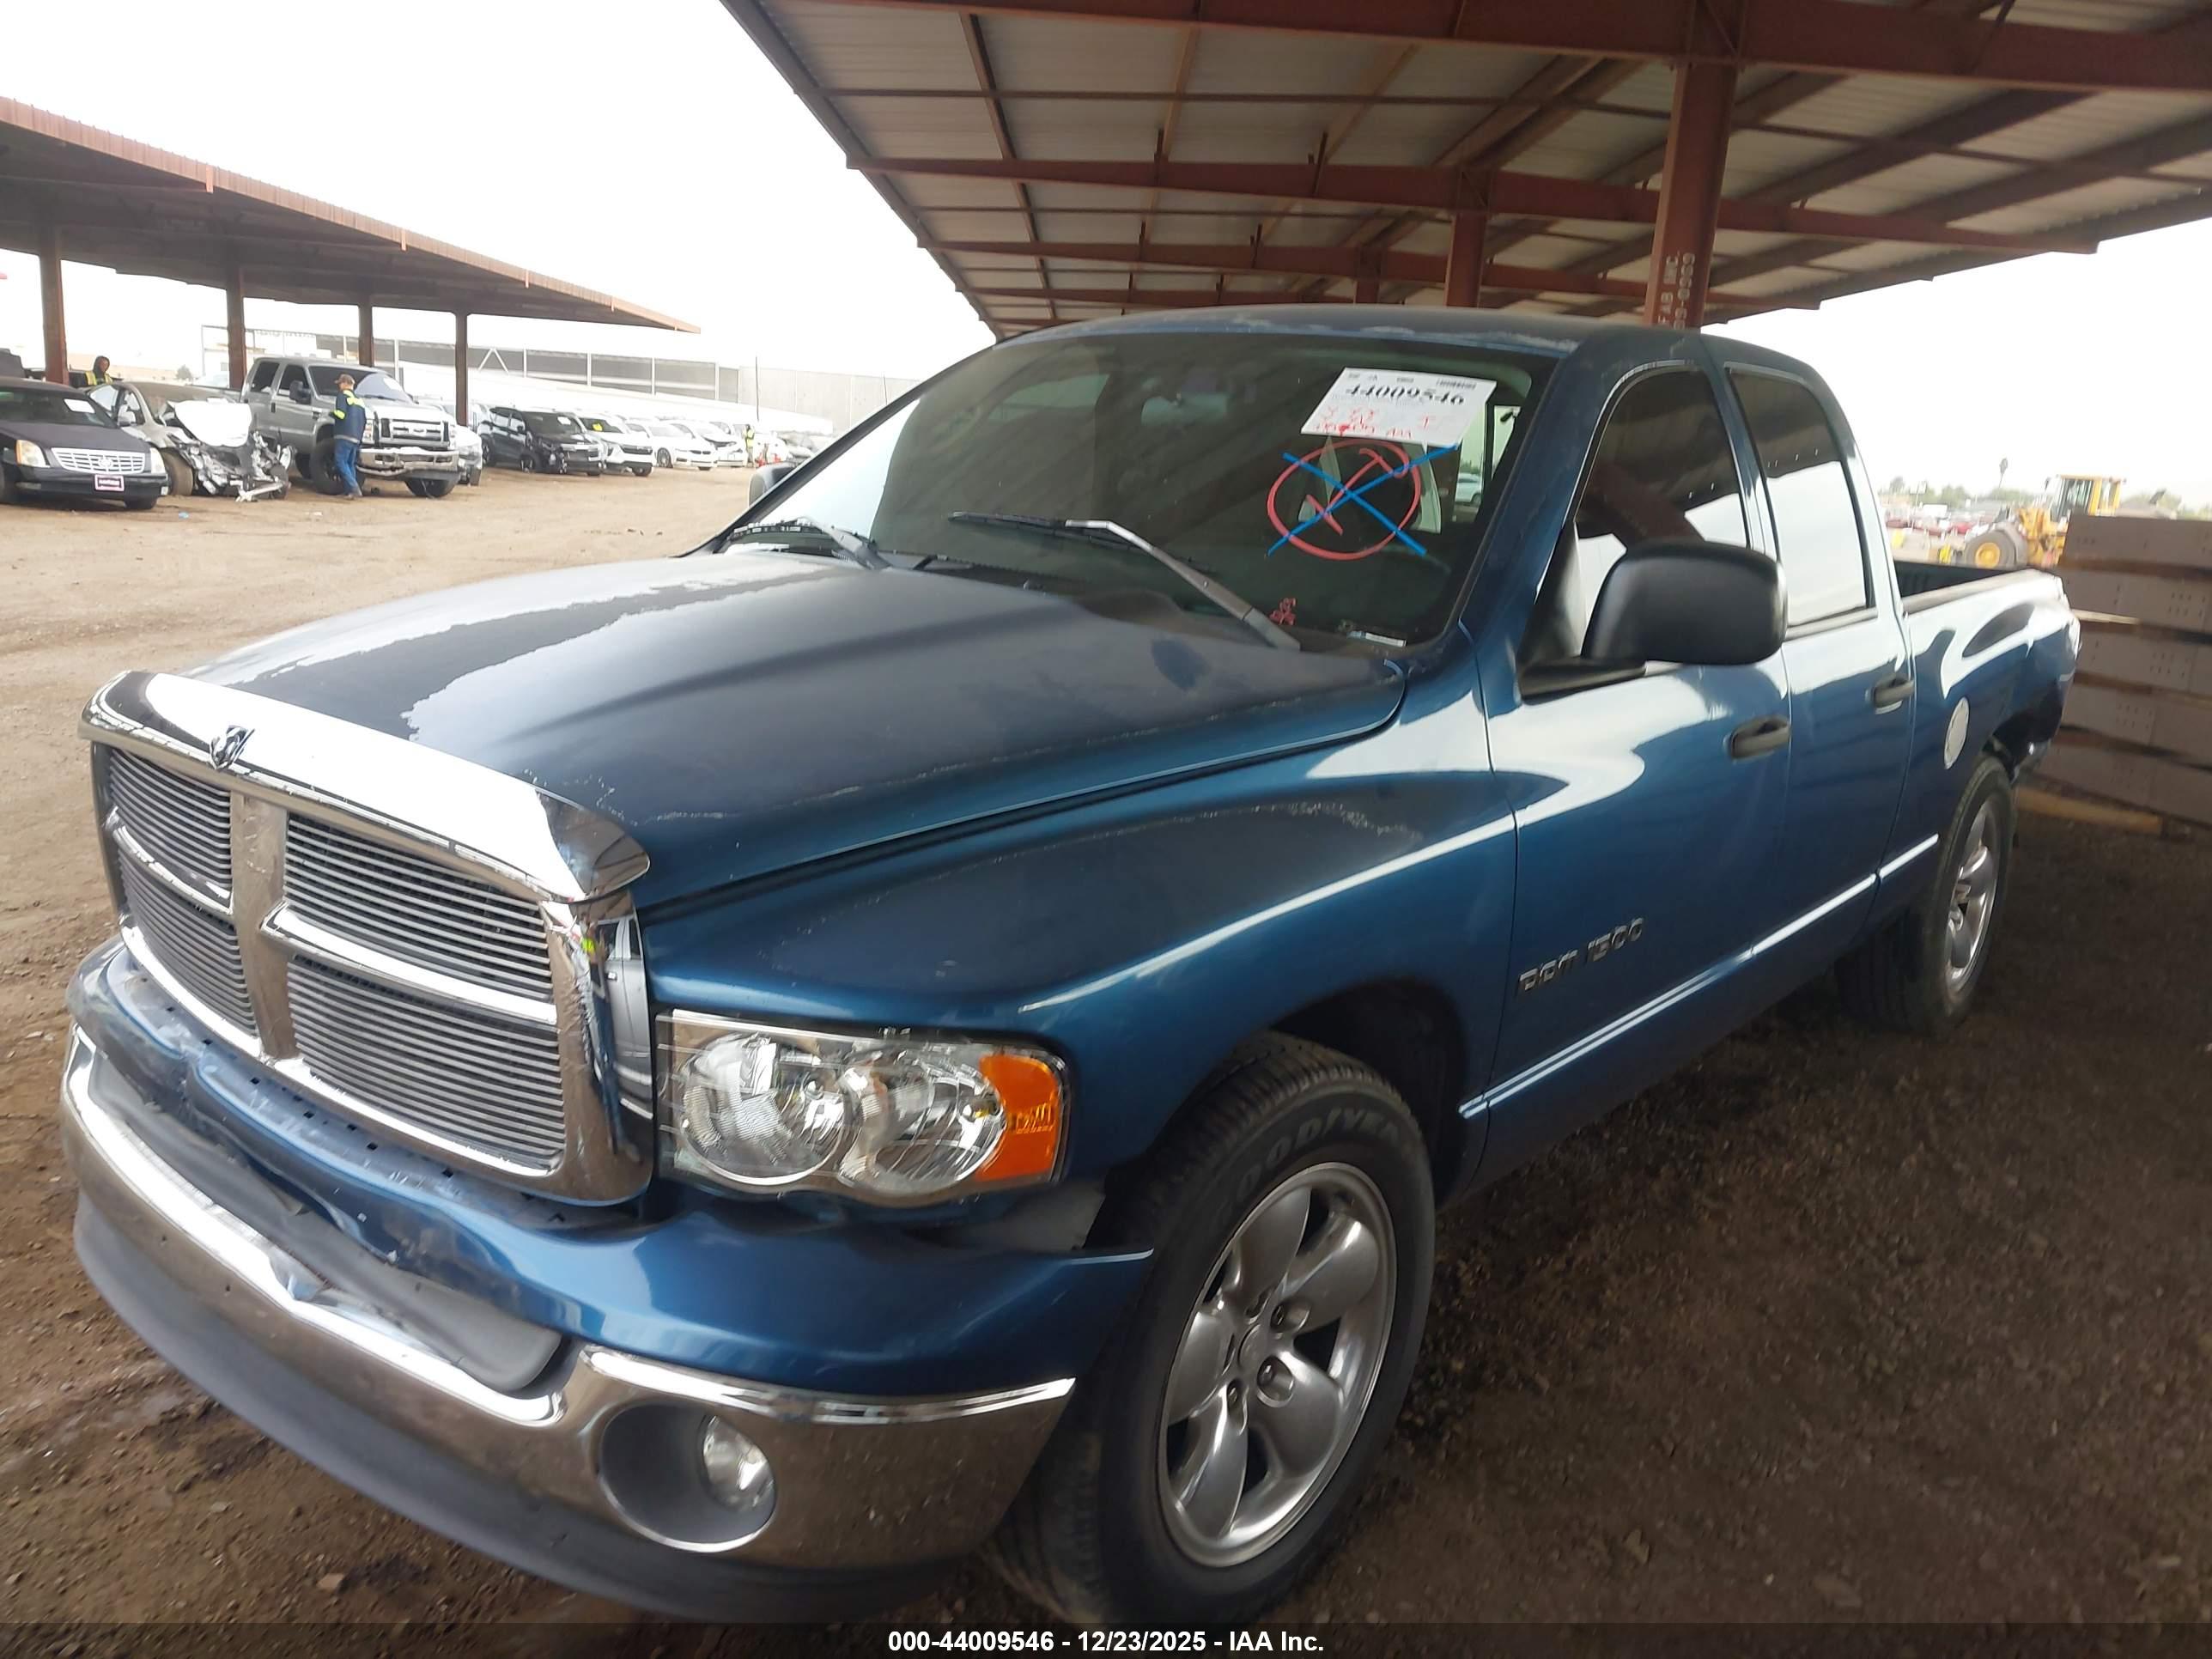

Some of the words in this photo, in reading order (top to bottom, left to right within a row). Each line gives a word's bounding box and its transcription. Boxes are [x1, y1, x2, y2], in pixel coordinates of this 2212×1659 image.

[1346, 383, 1464, 405] 44009546
[1587, 917, 1644, 963] 1500
[1209, 1107, 1413, 1237] GOODYEA
